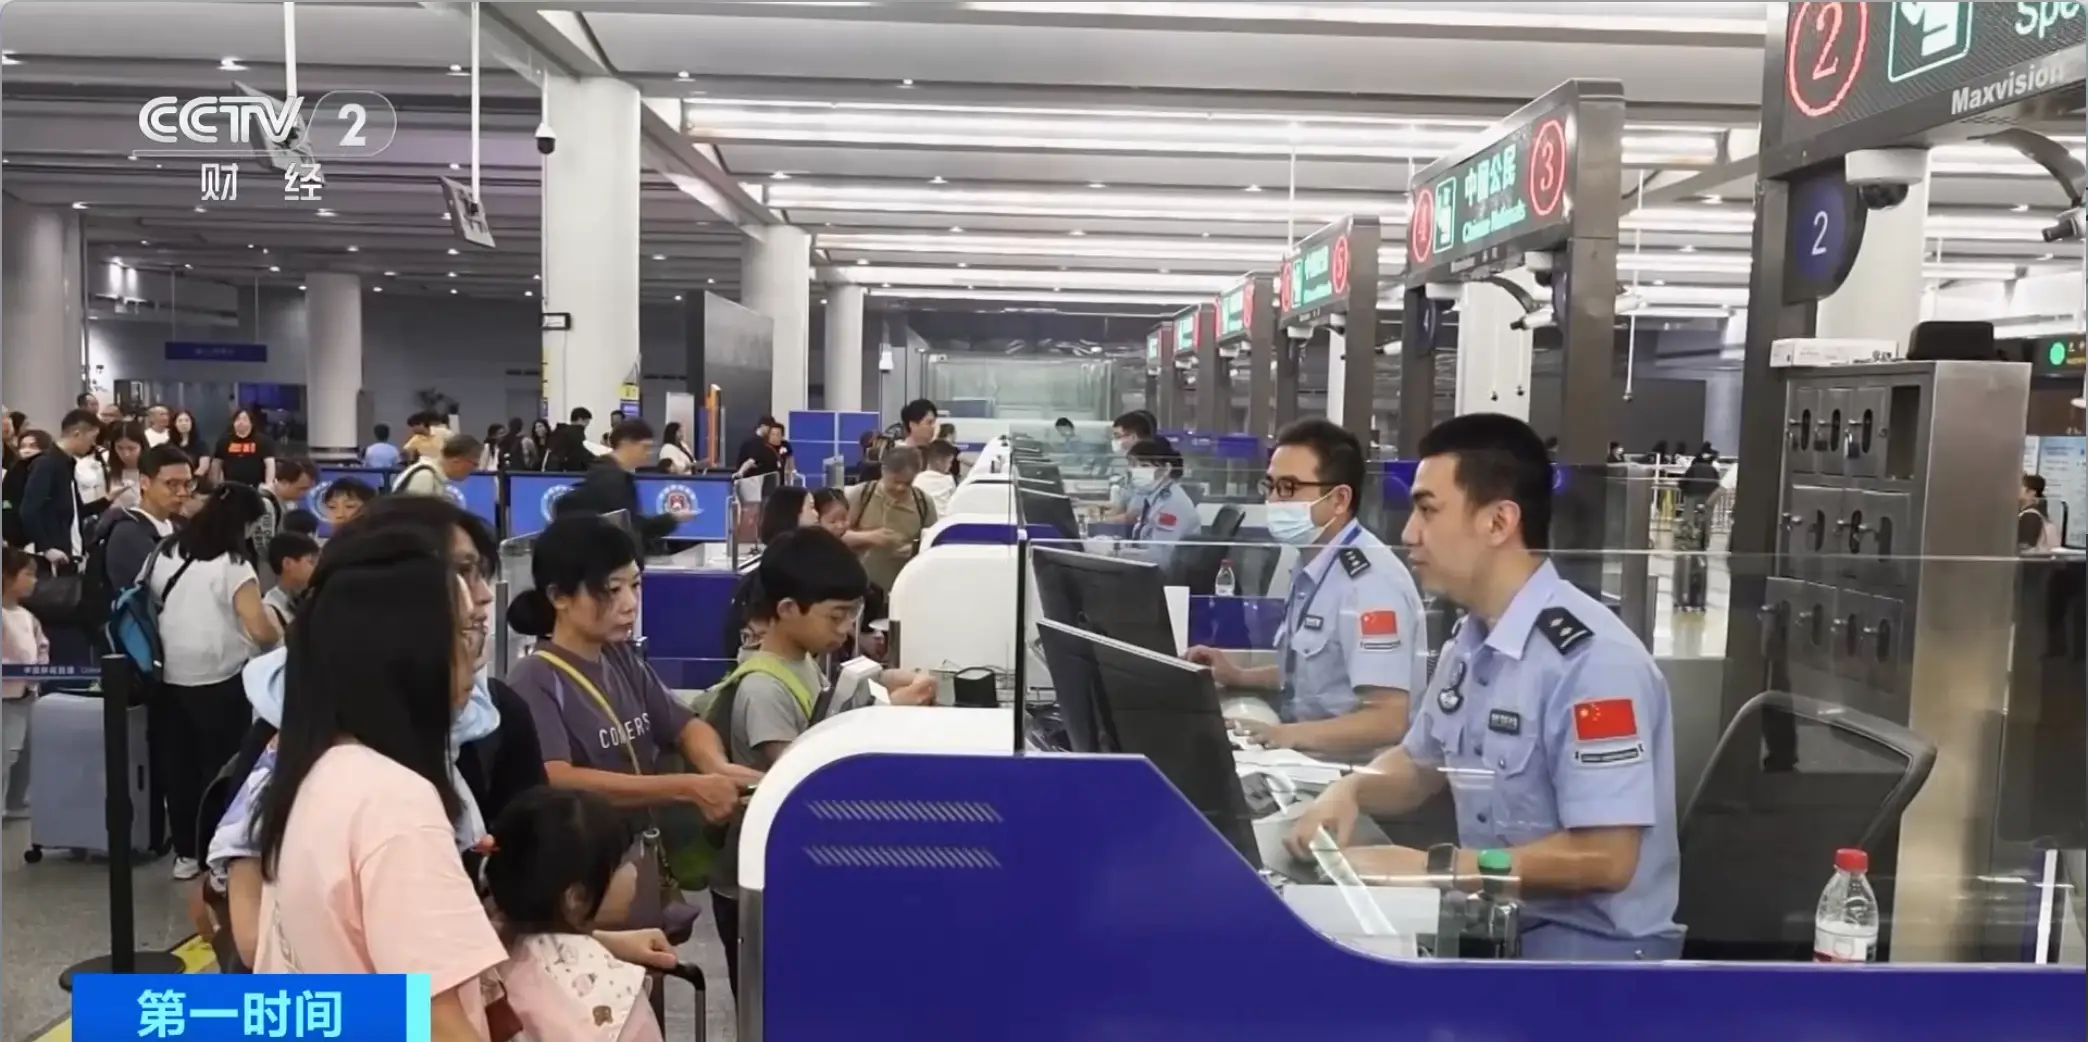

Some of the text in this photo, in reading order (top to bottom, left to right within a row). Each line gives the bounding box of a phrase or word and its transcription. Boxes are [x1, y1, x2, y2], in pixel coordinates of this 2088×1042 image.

[1813, 3, 1843, 81] 2
[1951, 63, 2064, 115] Maxvision
[1539, 142, 1554, 192] 3
[1811, 210, 1829, 256] 2
